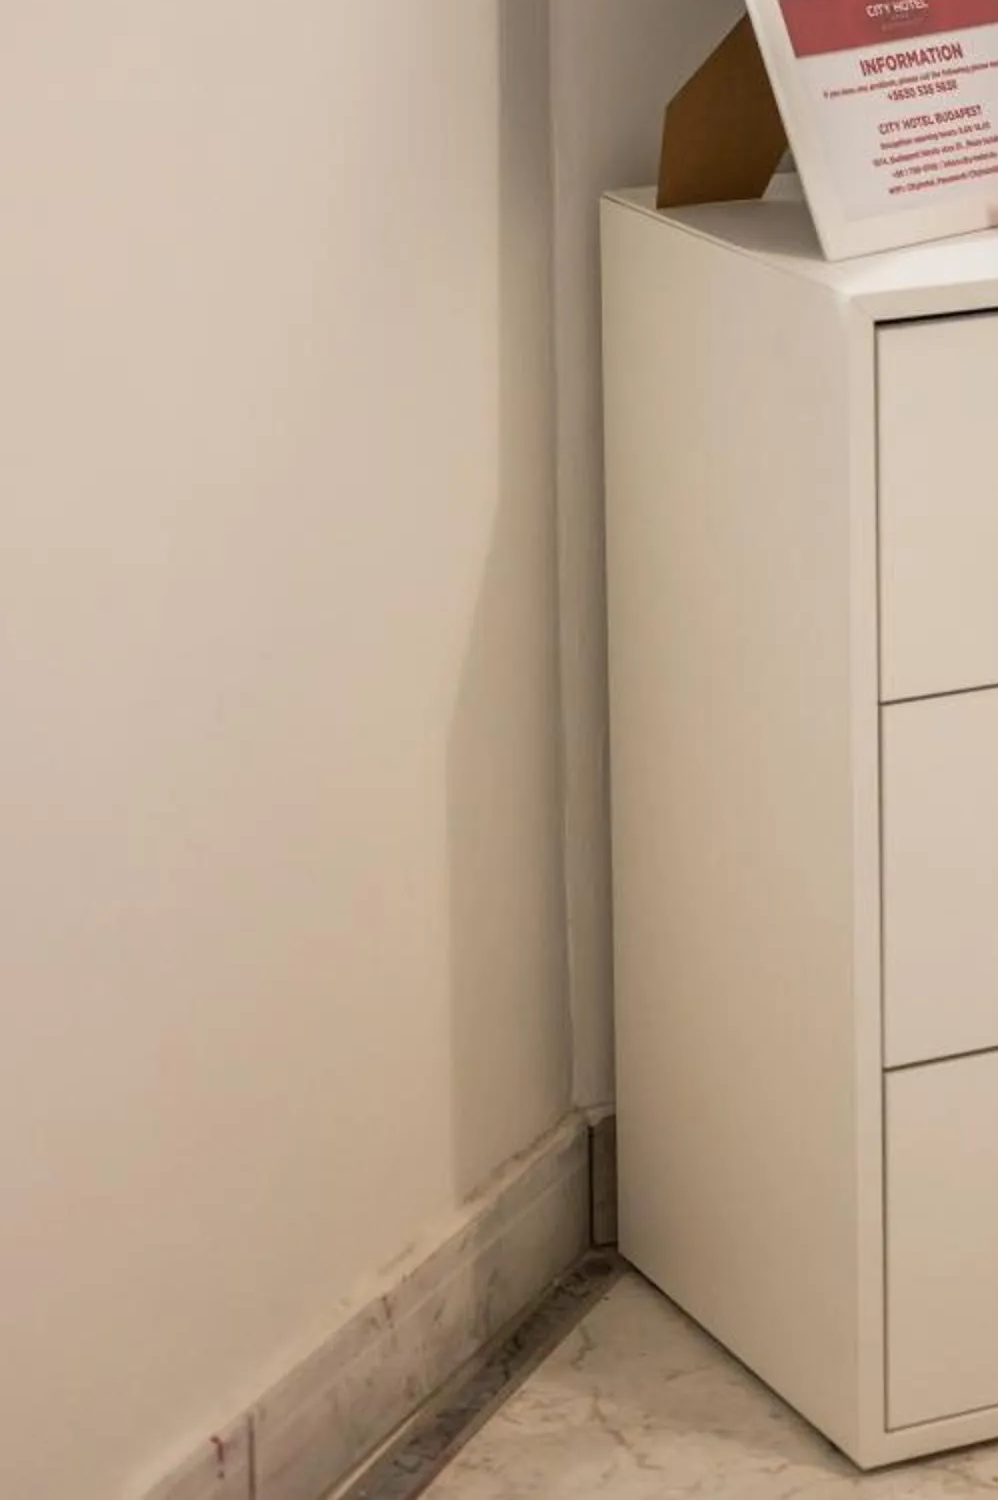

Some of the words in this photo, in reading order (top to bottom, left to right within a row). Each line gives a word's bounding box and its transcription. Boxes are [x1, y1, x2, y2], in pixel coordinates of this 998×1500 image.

[865, 3, 890, 17] CITY
[859, 43, 964, 76] INFORMATION
[878, 122, 900, 135] CITY
[902, 115, 934, 129] HOTEL
[934, 104, 981, 123] BUDAPEST
